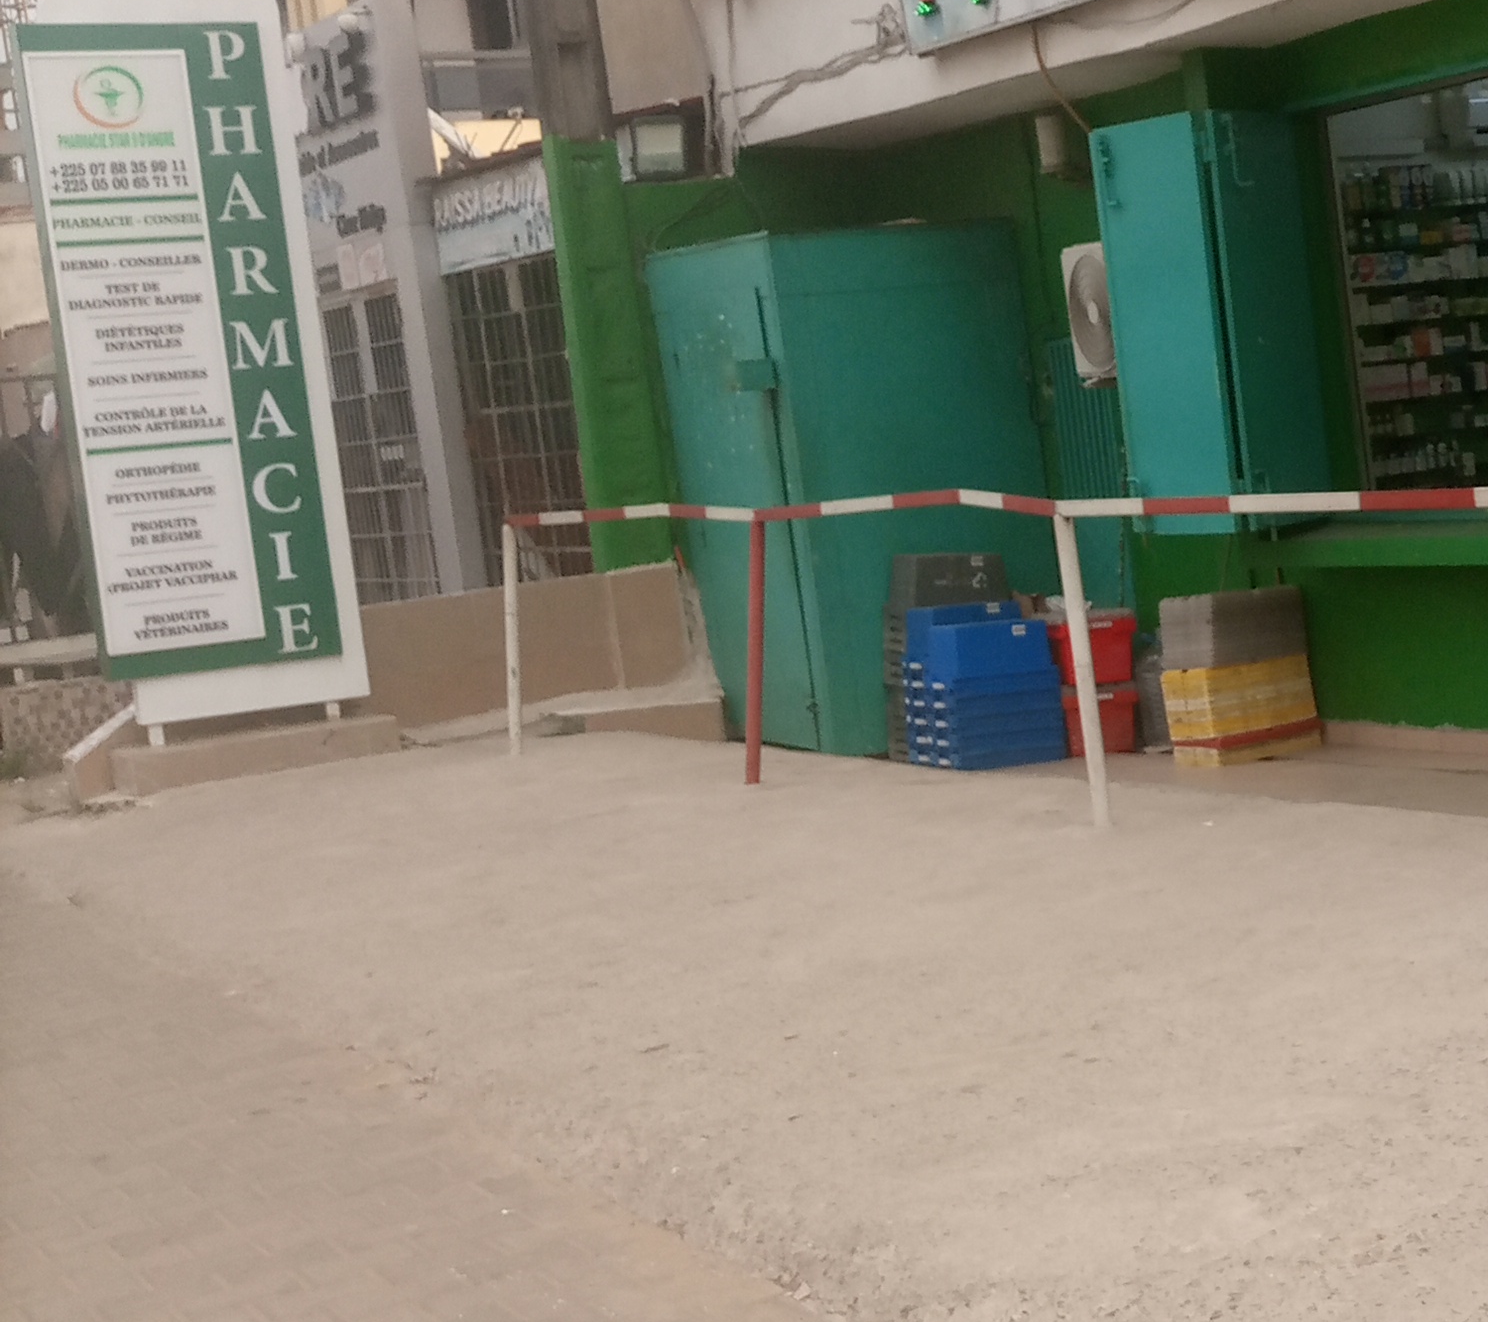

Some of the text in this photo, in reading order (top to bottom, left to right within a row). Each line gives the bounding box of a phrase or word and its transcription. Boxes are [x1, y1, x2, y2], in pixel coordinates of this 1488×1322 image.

[50, 158, 187, 178] +225 07 88 35 99 11
[52, 177, 88, 193] +225
[92, 176, 109, 191] 05
[112, 176, 130, 190] 00
[154, 175, 170, 188] 71
[173, 174, 189, 187] 71
[52, 214, 133, 230] PHARMACIE
[144, 212, 203, 226] CONSEIL
[60, 258, 109, 272] DERMO
[119, 254, 203, 268] CONSEILLER
[105, 282, 160, 295] TEST DE
[69, 292, 203, 311] DIAGNOSTIC RAPIDE
[105, 337, 183, 352] INFANTILES
[202, 29, 319, 655] PHARMACIE
[87, 368, 209, 387] SOINS INFIRMIERS
[170, 405, 187, 416] DE
[190, 404, 208, 415] LA
[84, 425, 142, 438] TENSION
[131, 517, 198, 532] PRODUITS
[131, 535, 149, 547] DE
[125, 560, 213, 577] VACCINATION
[144, 609, 211, 626] PRODUITS
